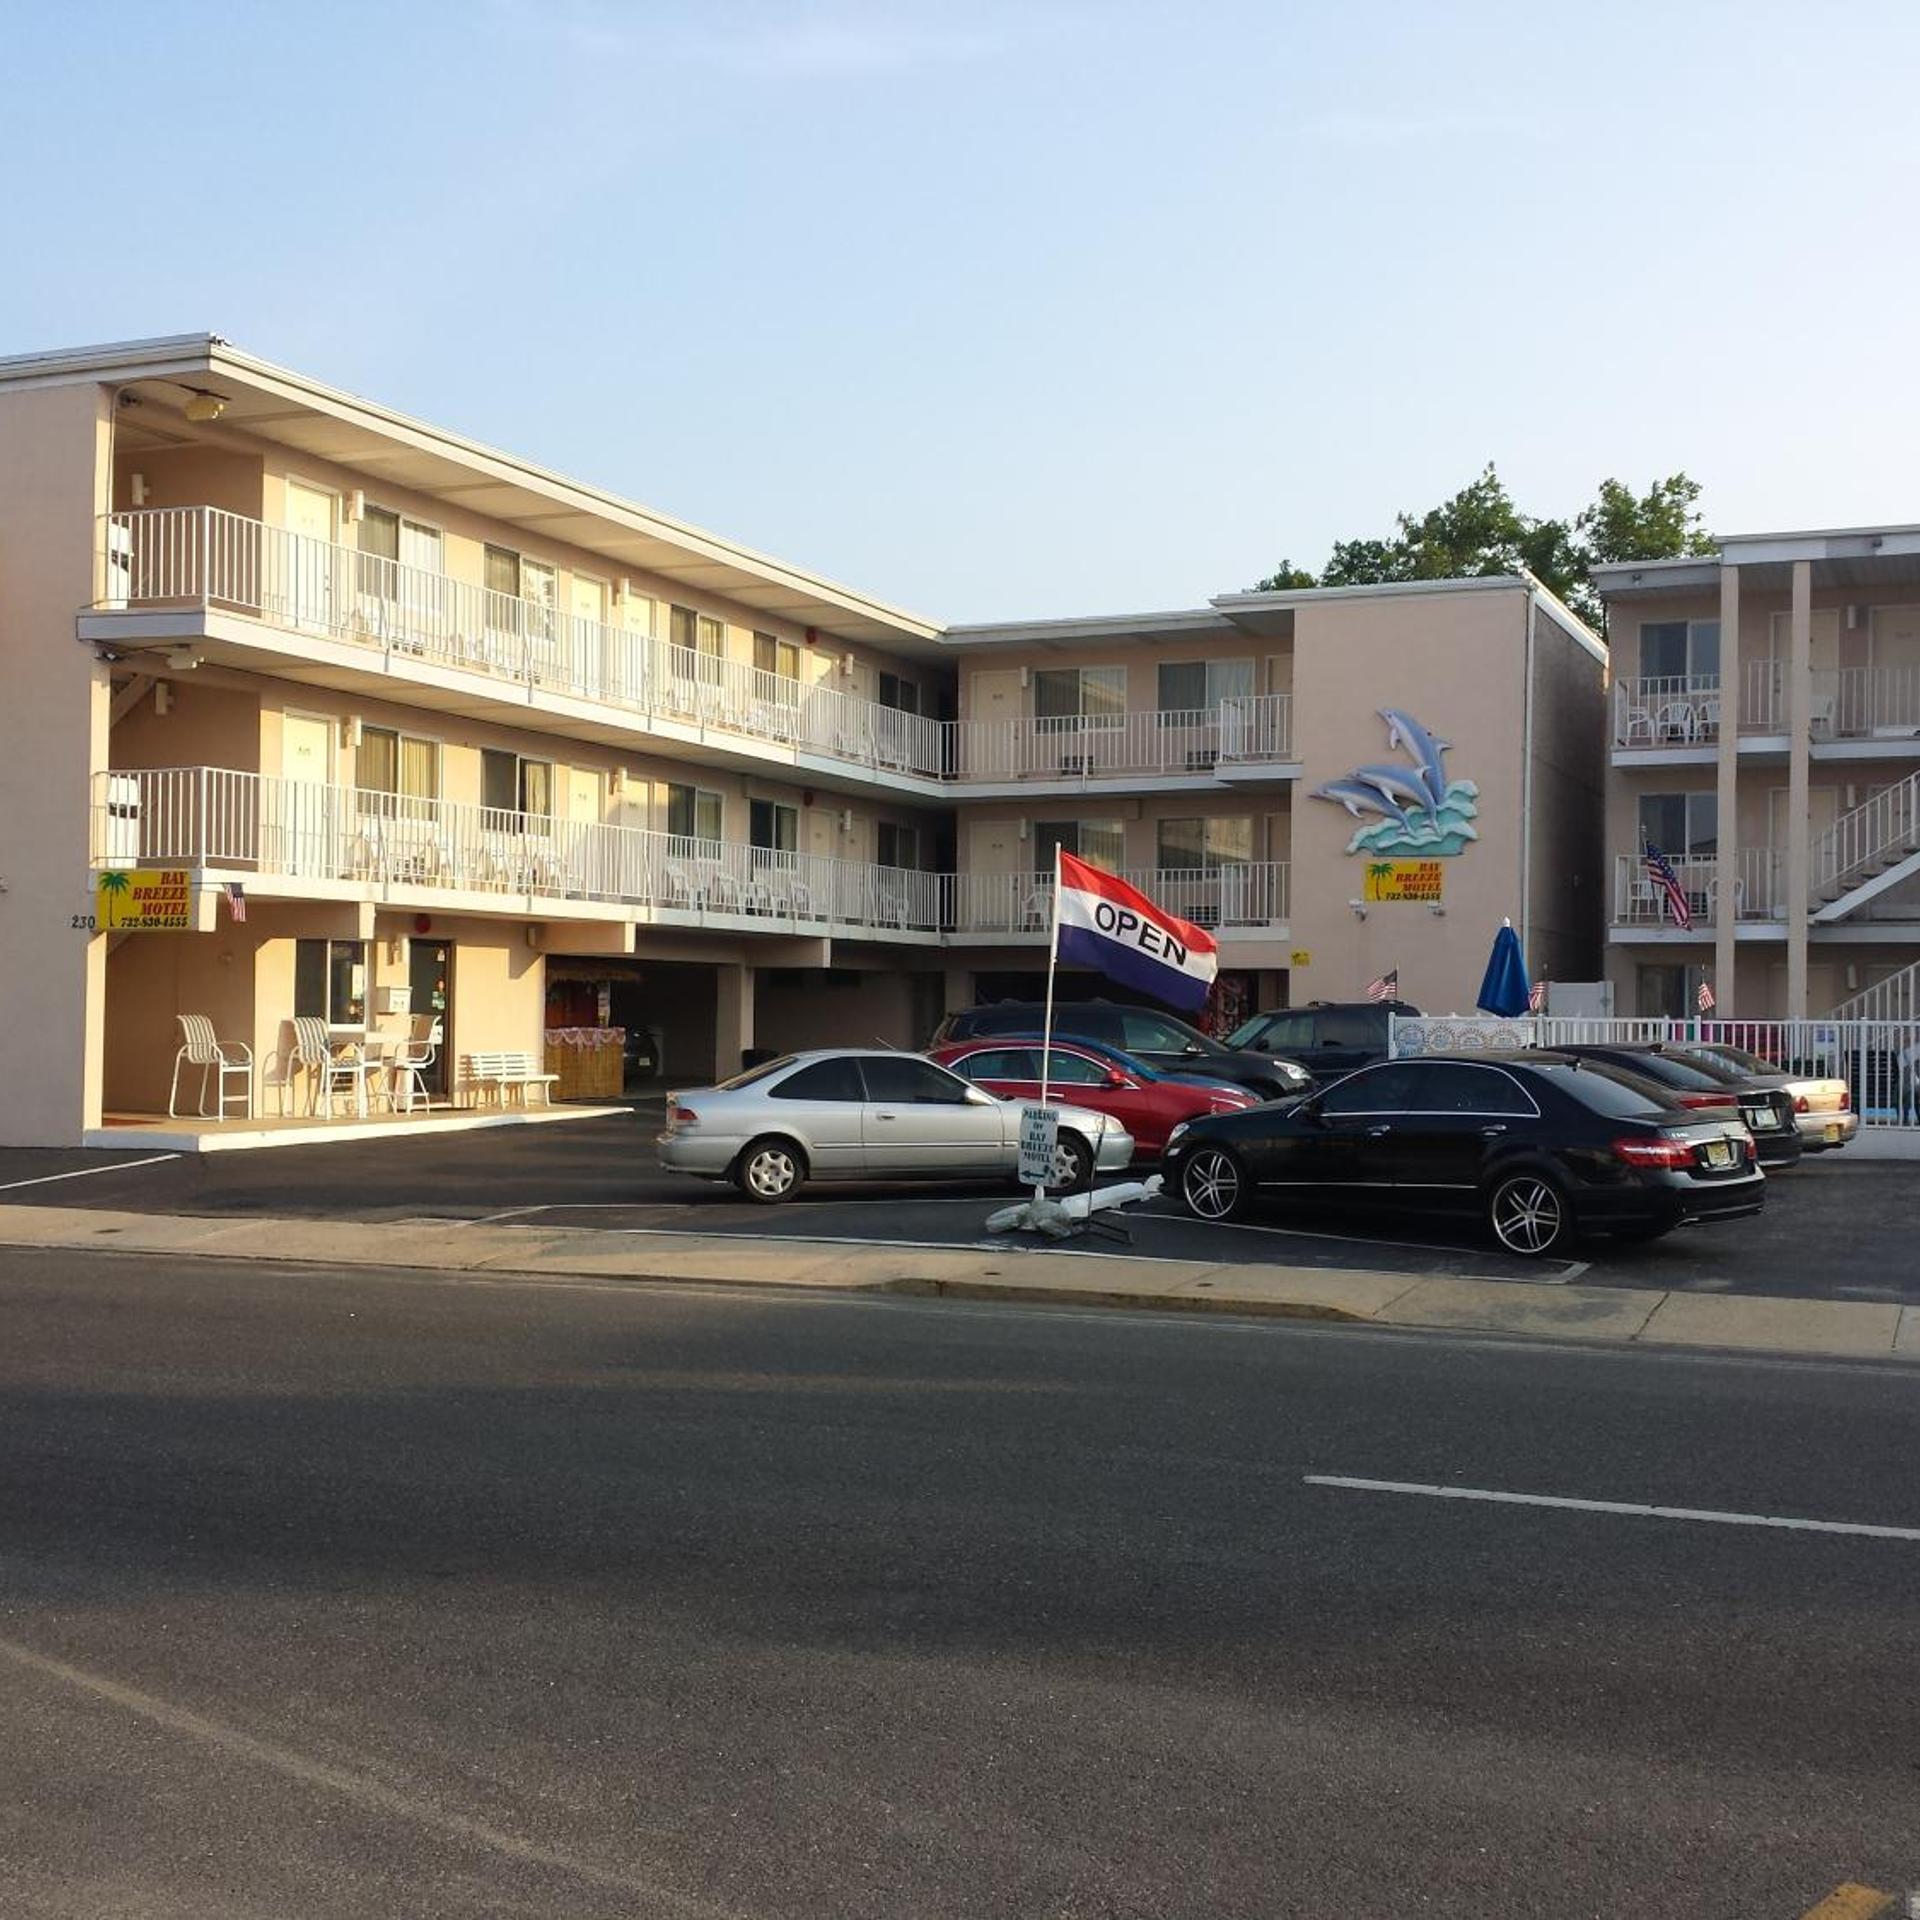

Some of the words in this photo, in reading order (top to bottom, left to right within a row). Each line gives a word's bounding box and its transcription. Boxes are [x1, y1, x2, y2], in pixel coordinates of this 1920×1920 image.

[1419, 862, 1441, 872] BAY
[160, 871, 187, 885] BAY
[1396, 872, 1441, 881] BREEZE
[132, 887, 188, 900] BREEZE
[1402, 882, 1441, 892] MOTEL
[141, 902, 188, 916] MOTEL
[71, 914, 96, 929] 230
[1095, 902, 1187, 966] OPEN
[1023, 1108, 1057, 1121] PARKING
[1029, 1131, 1046, 1142] BAY
